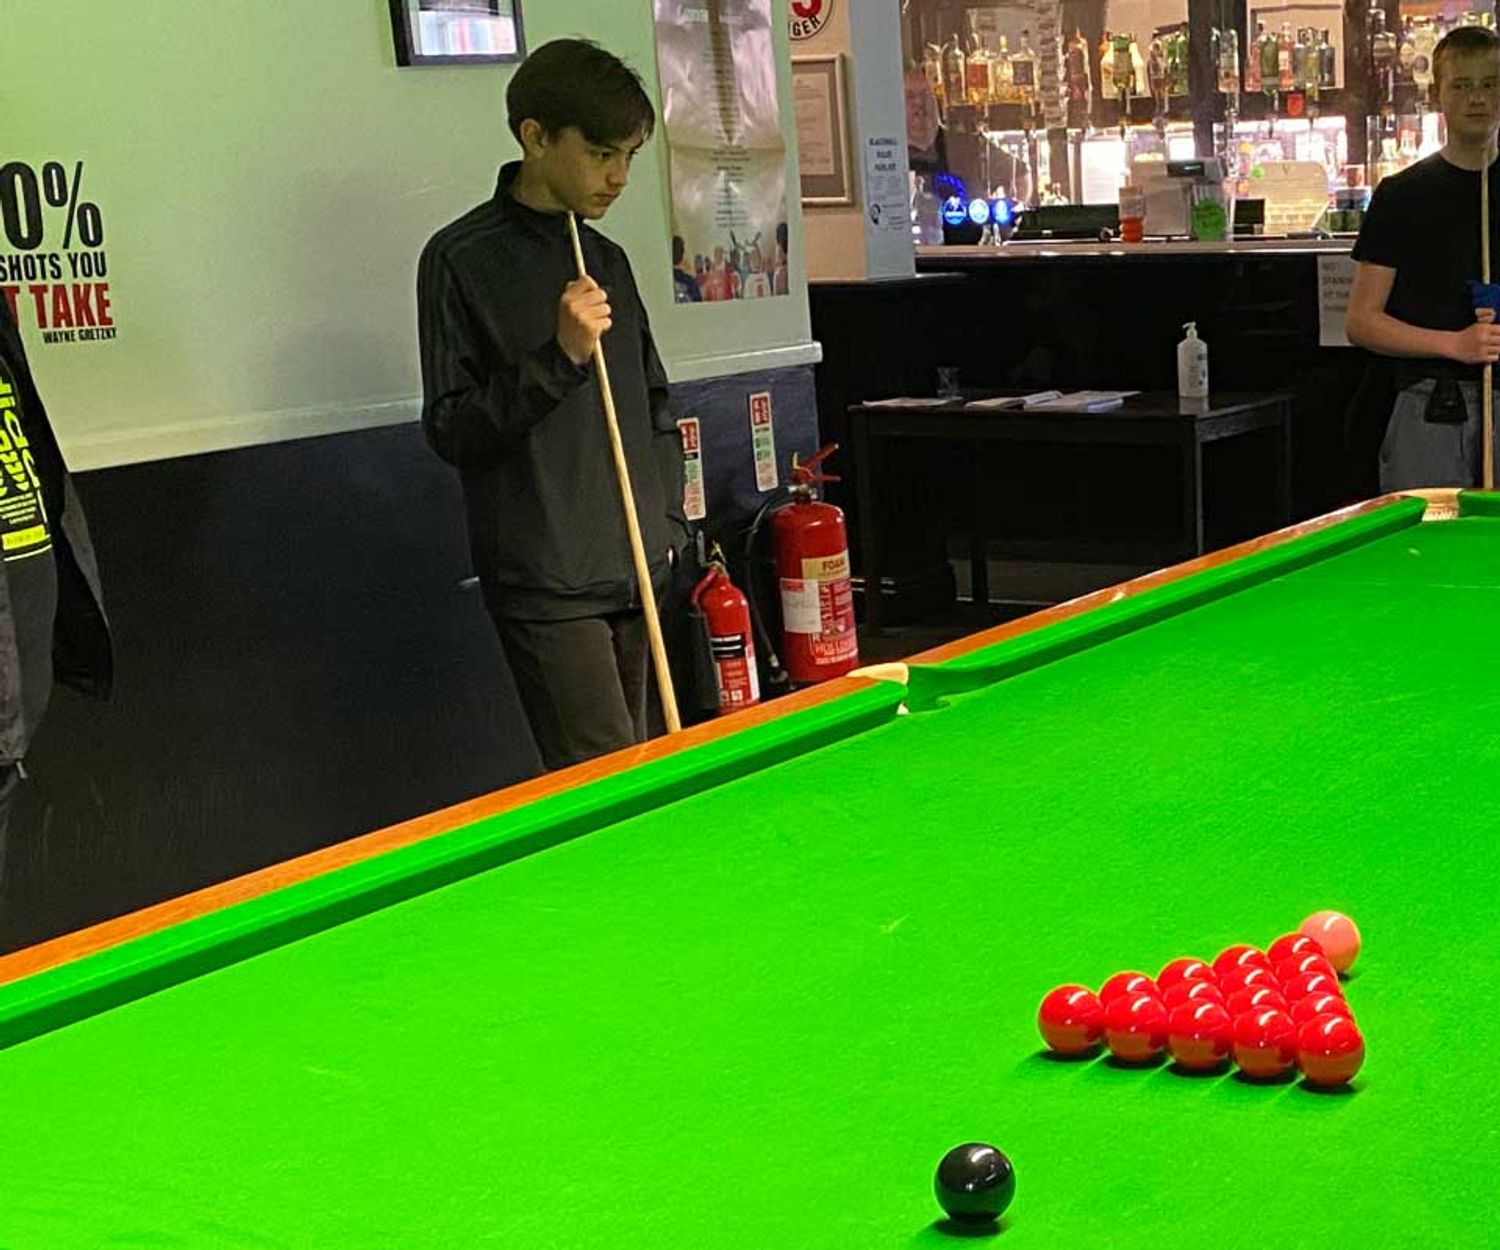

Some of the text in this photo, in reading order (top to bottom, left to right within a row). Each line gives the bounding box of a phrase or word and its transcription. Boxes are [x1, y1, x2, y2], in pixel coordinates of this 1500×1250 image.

[788, 15, 821, 36] GER
[68, 251, 107, 279] YOU
[29, 283, 113, 329] TAKE
[43, 327, 117, 344] WAYNE GRETZKY
[822, 559, 845, 572] FOAM
